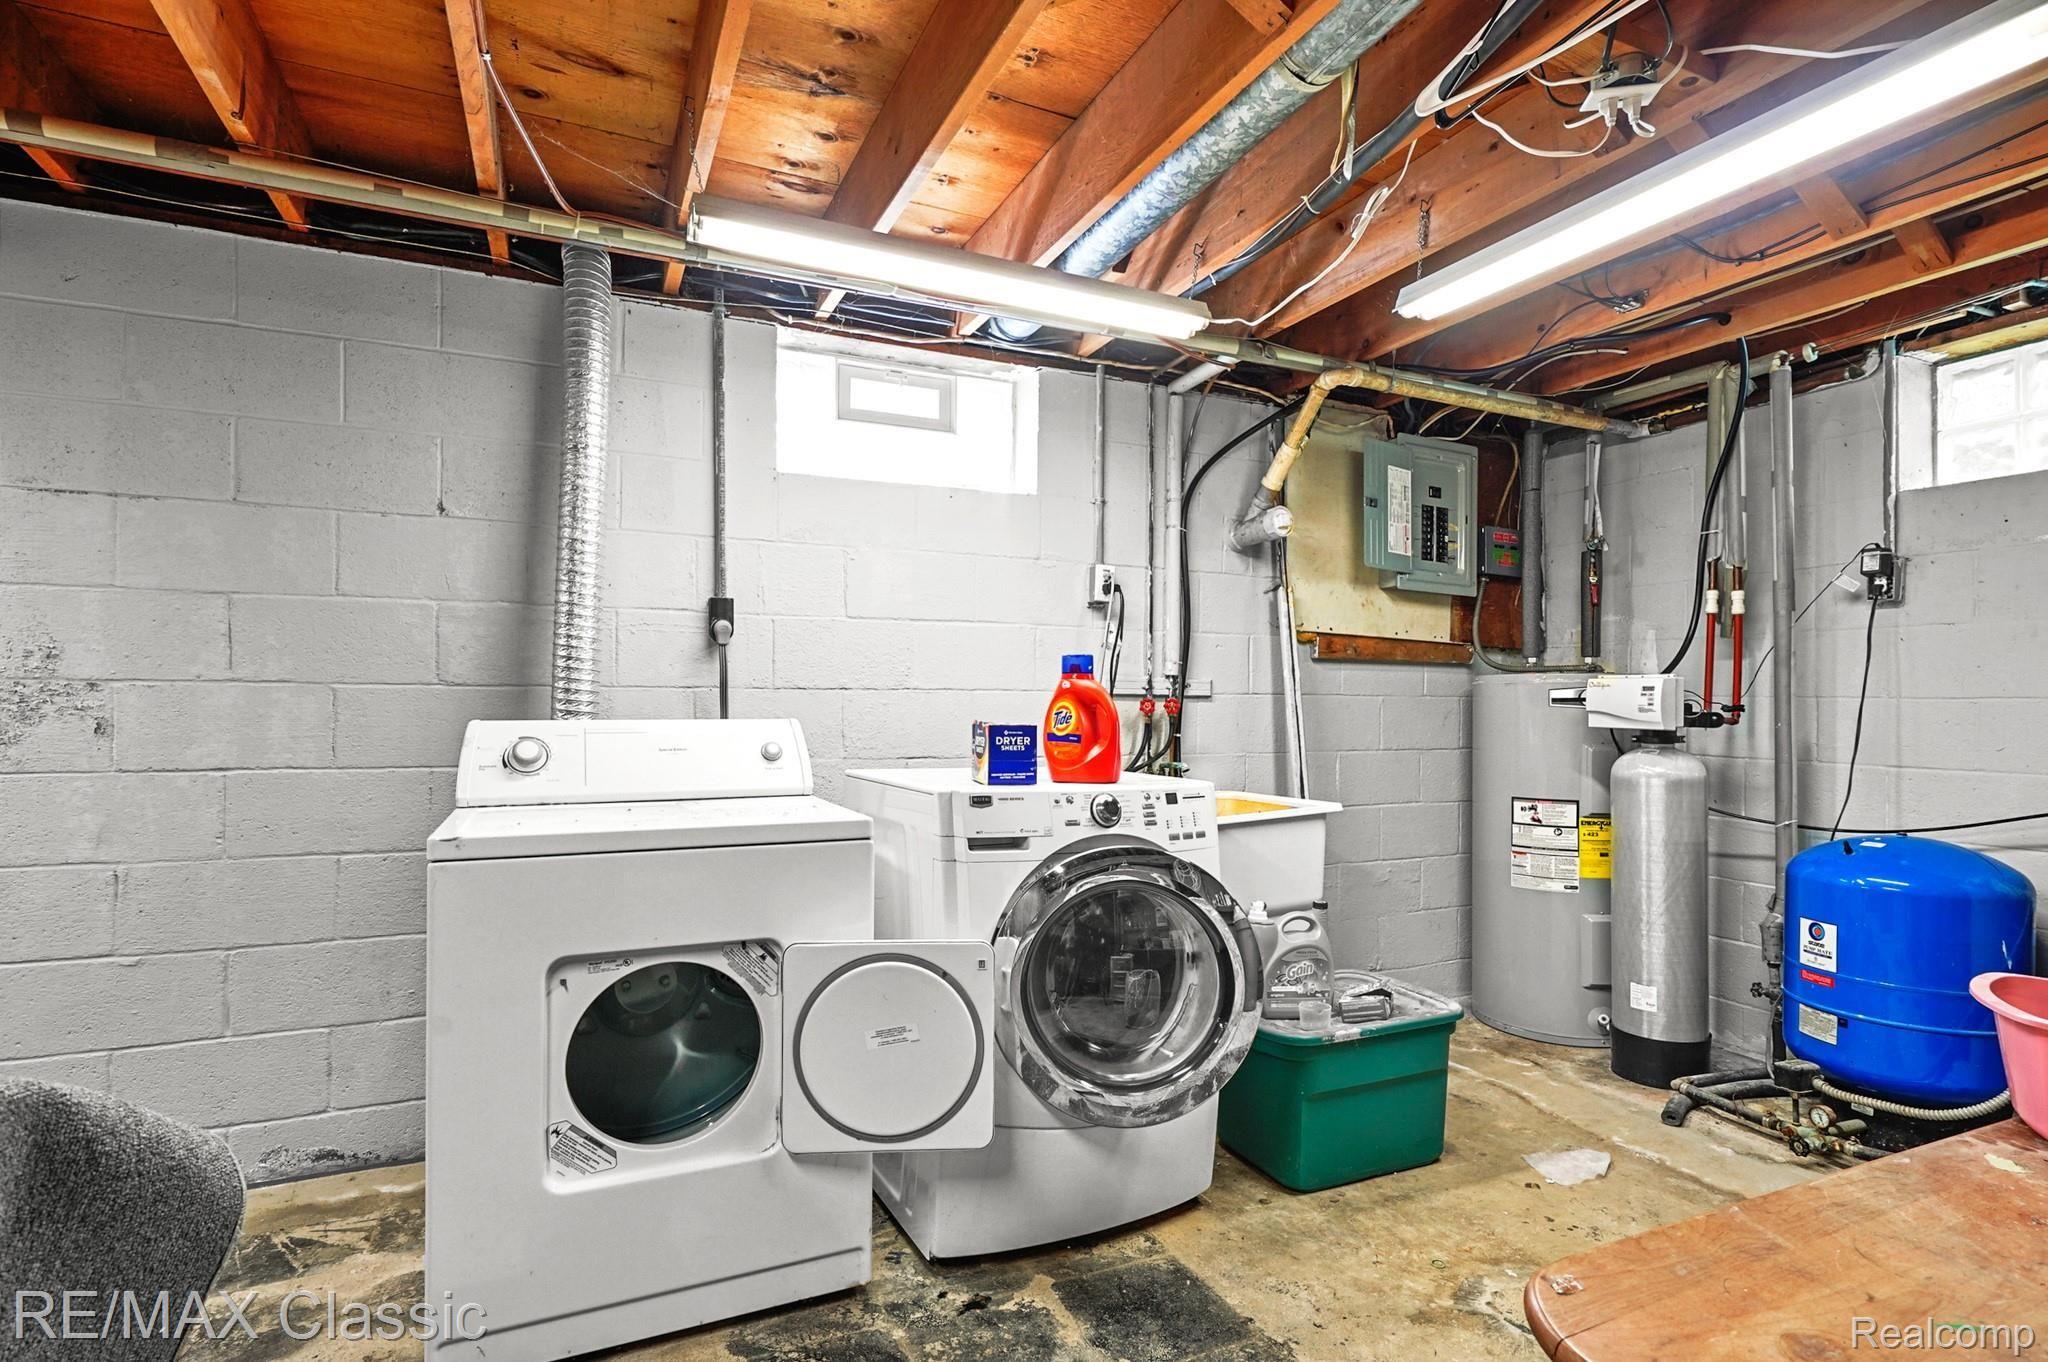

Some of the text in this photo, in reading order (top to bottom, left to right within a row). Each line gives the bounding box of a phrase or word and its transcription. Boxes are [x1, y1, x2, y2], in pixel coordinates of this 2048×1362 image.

[1053, 711, 1072, 728] Tide
[995, 736, 1031, 745] DRYER
[1286, 961, 1314, 980] Gain
